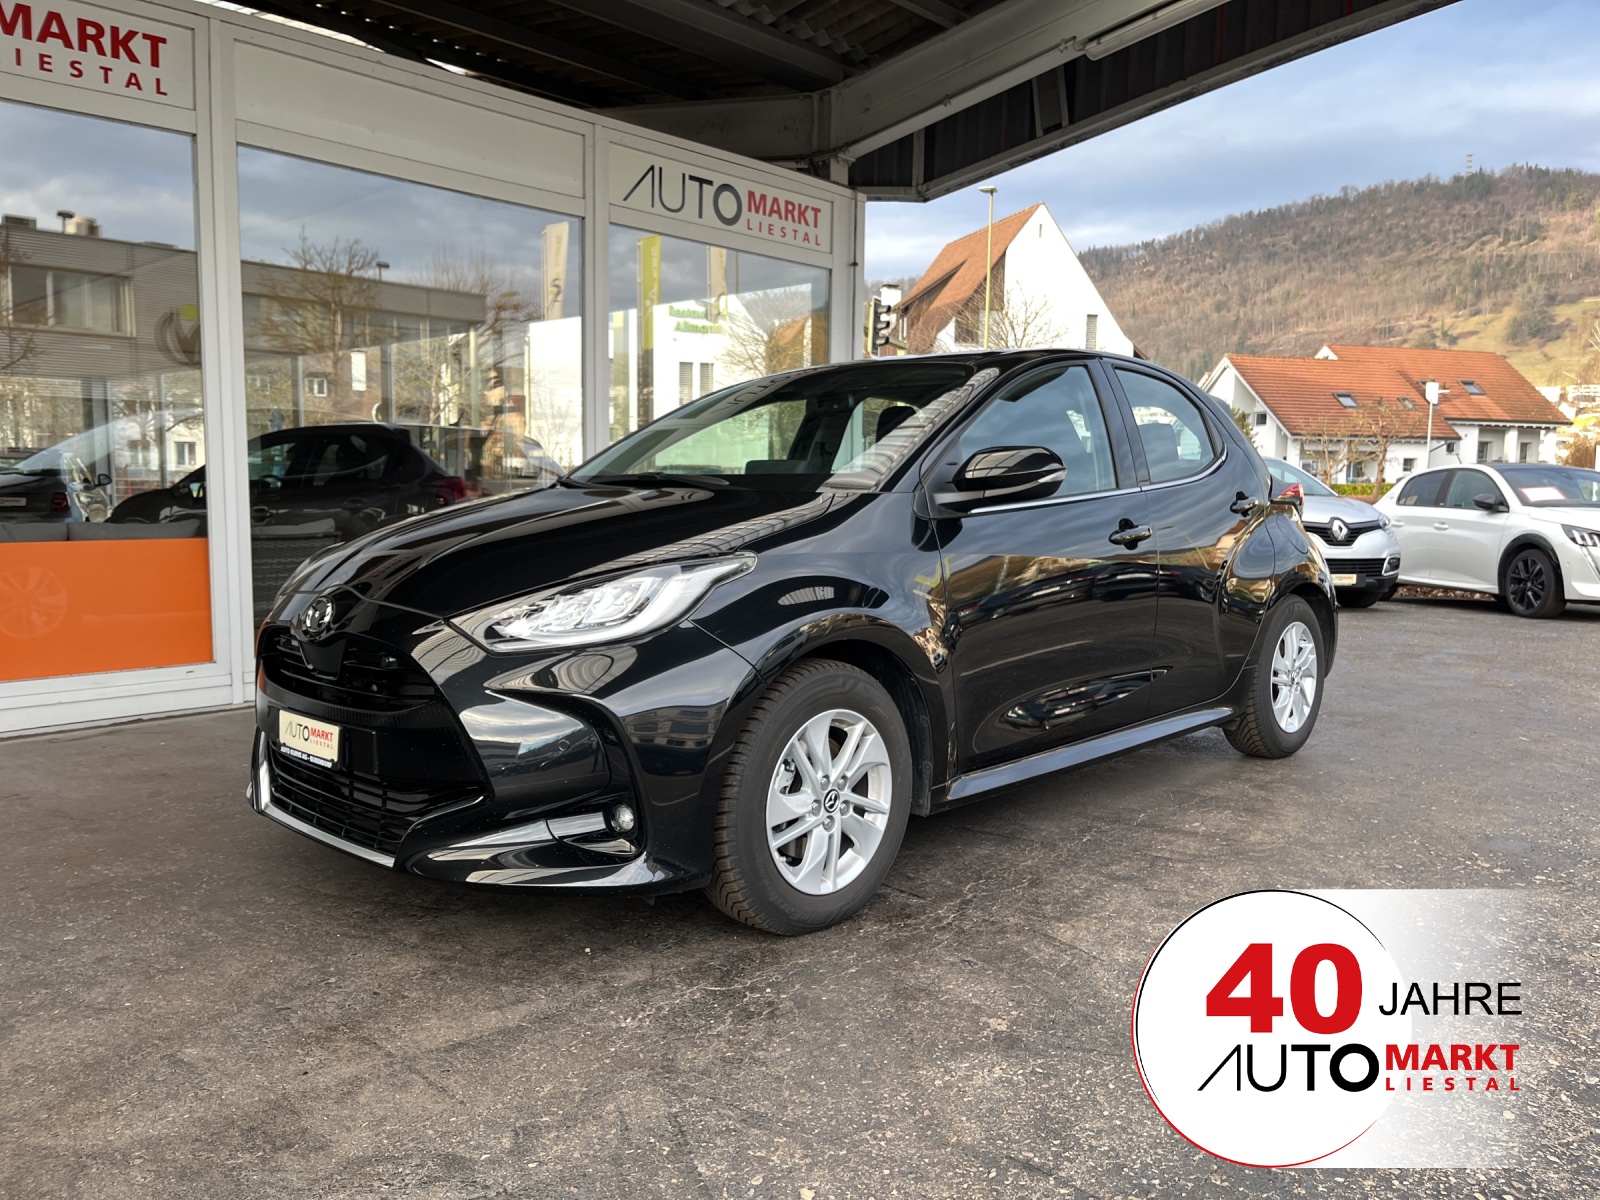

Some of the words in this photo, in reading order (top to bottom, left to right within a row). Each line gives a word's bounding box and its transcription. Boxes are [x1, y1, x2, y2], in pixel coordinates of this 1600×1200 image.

[0, 3, 167, 69] MARKT
[14, 47, 168, 97] IESTAL
[622, 164, 743, 227] AUTO
[747, 190, 821, 229] MARKT
[746, 218, 821, 246] LIESTAL
[285, 720, 310, 742] AUTO
[310, 727, 334, 743] MARKT
[310, 739, 334, 750] LIESTAL
